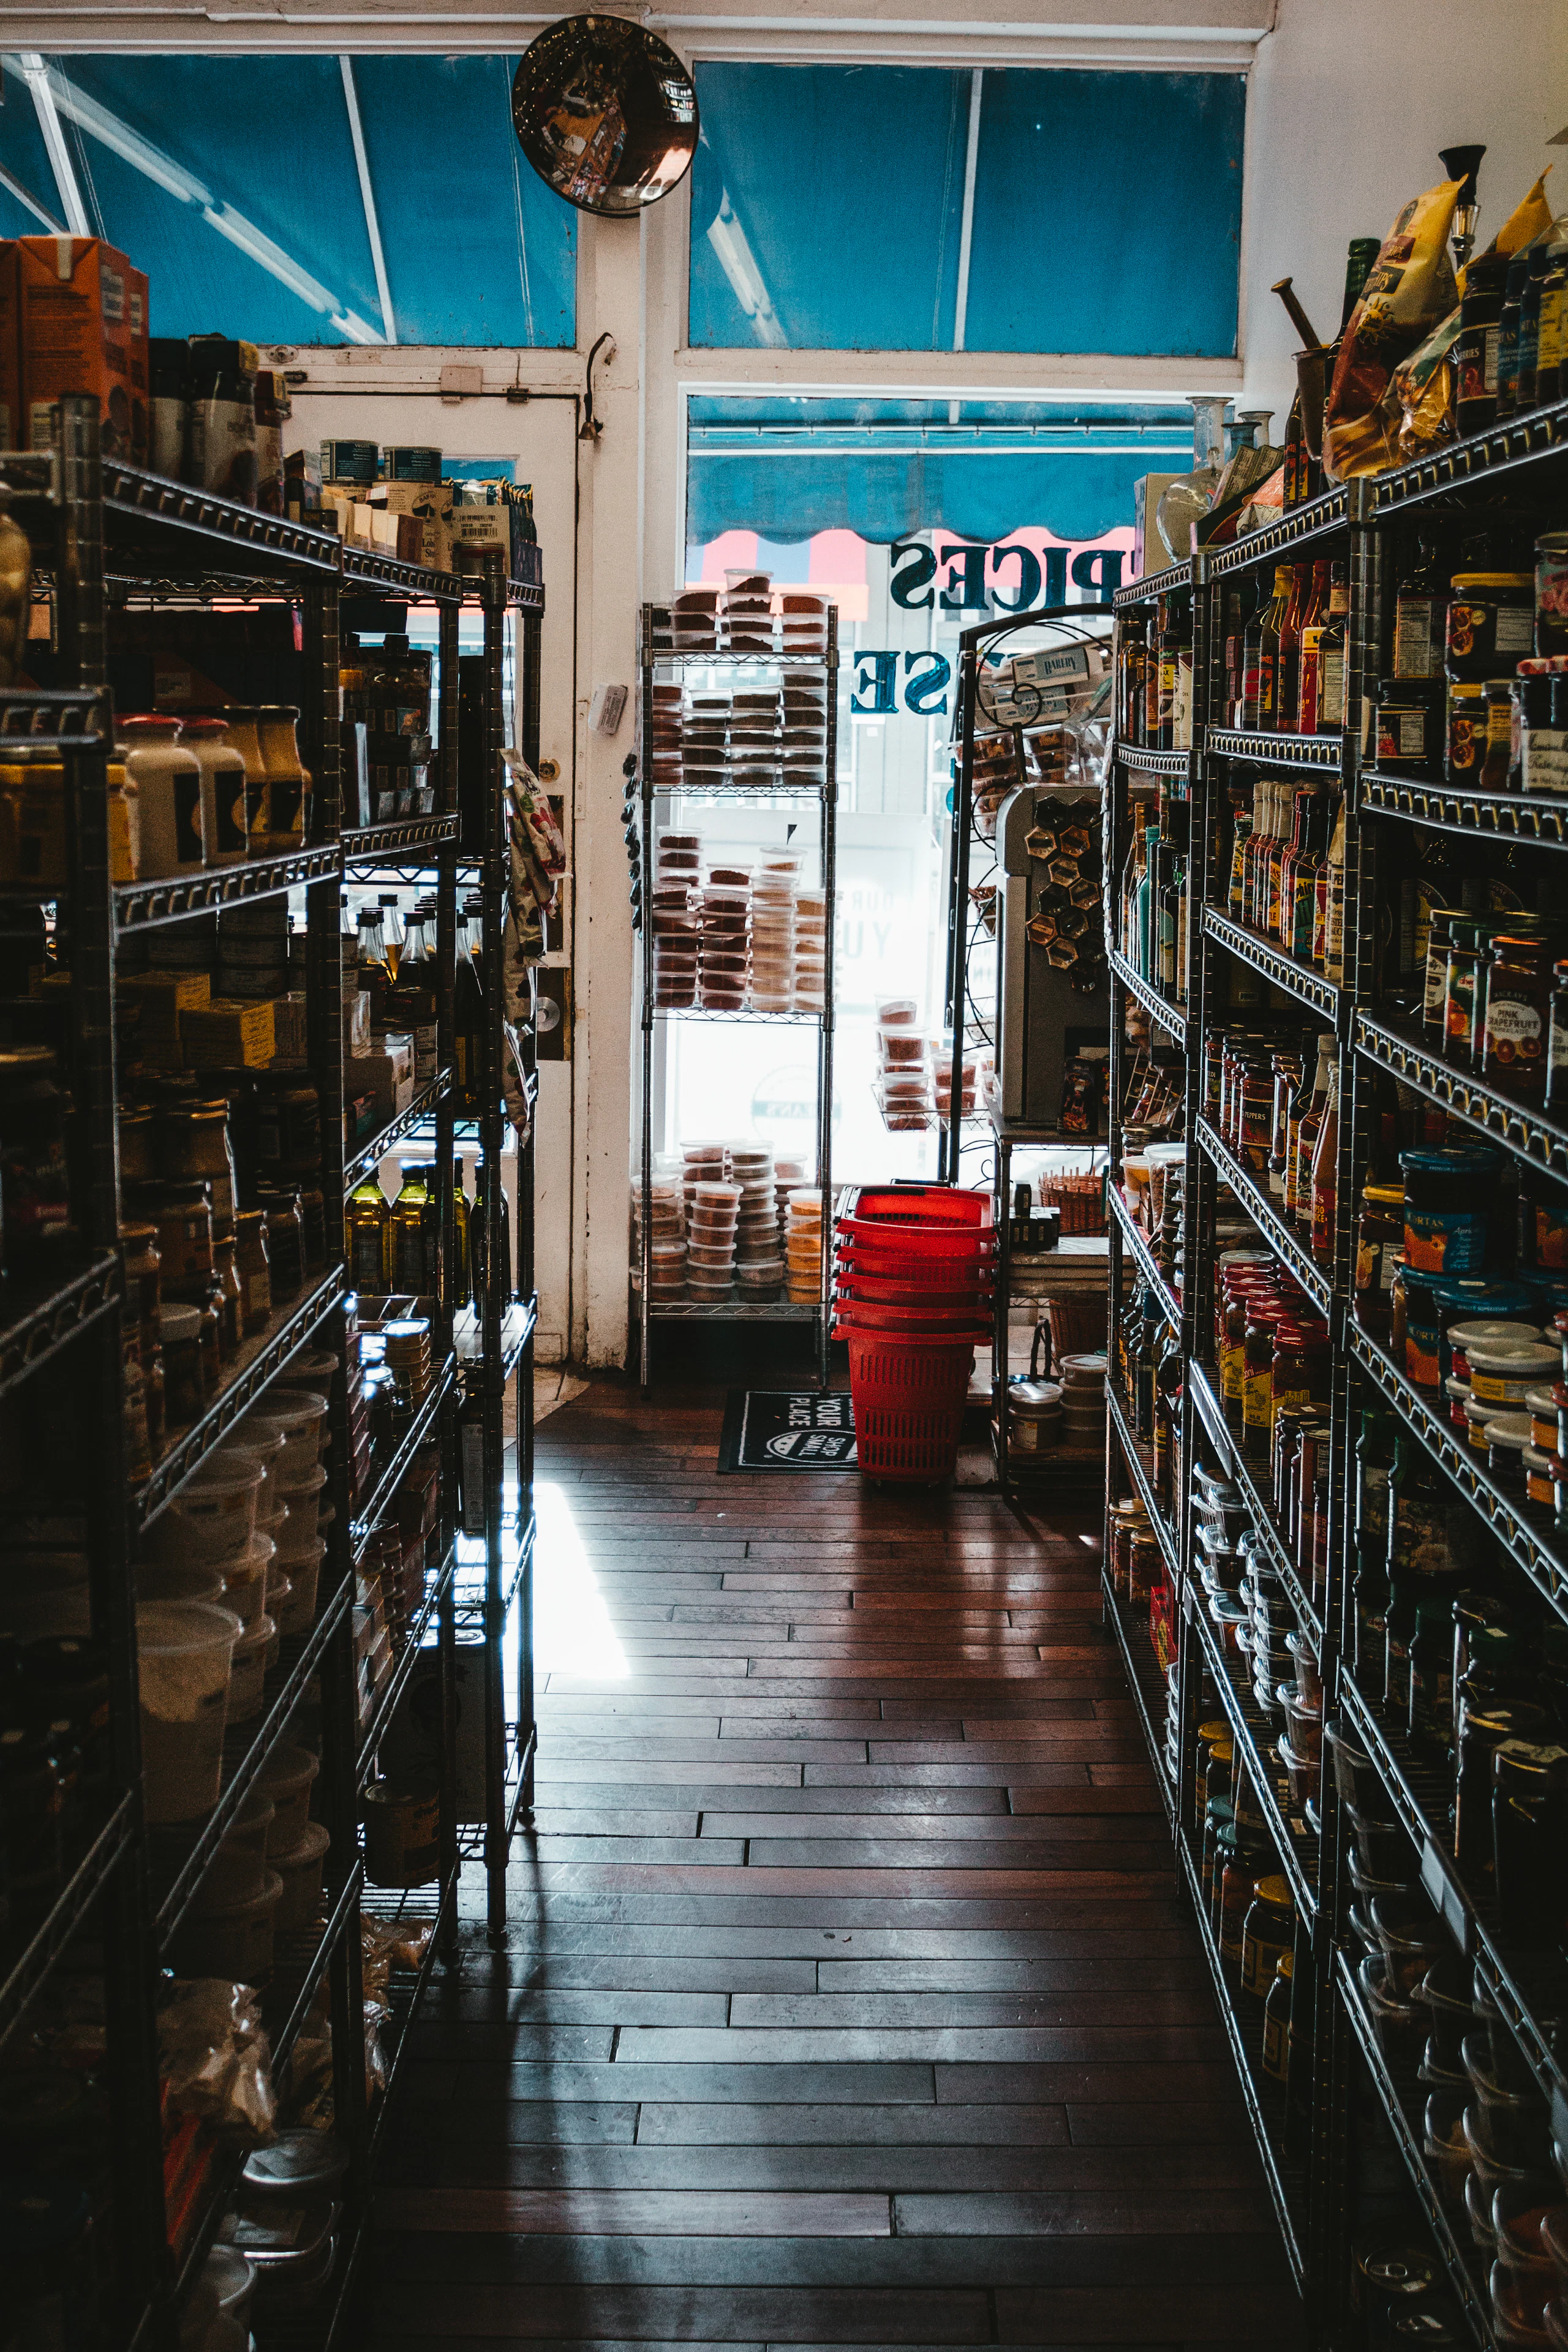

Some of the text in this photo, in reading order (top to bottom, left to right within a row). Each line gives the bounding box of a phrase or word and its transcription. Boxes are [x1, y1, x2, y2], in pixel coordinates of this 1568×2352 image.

[1044, 657, 1076, 675] BAKERY
[1497, 1009, 1518, 1019] PINK
[1406, 1210, 1444, 1228] CORTAS
[788, 1398, 812, 1427] PLACE
[816, 1398, 842, 1427] YOUR
[797, 1434, 827, 1457] SMALL
[820, 1438, 846, 1457] SHOP
